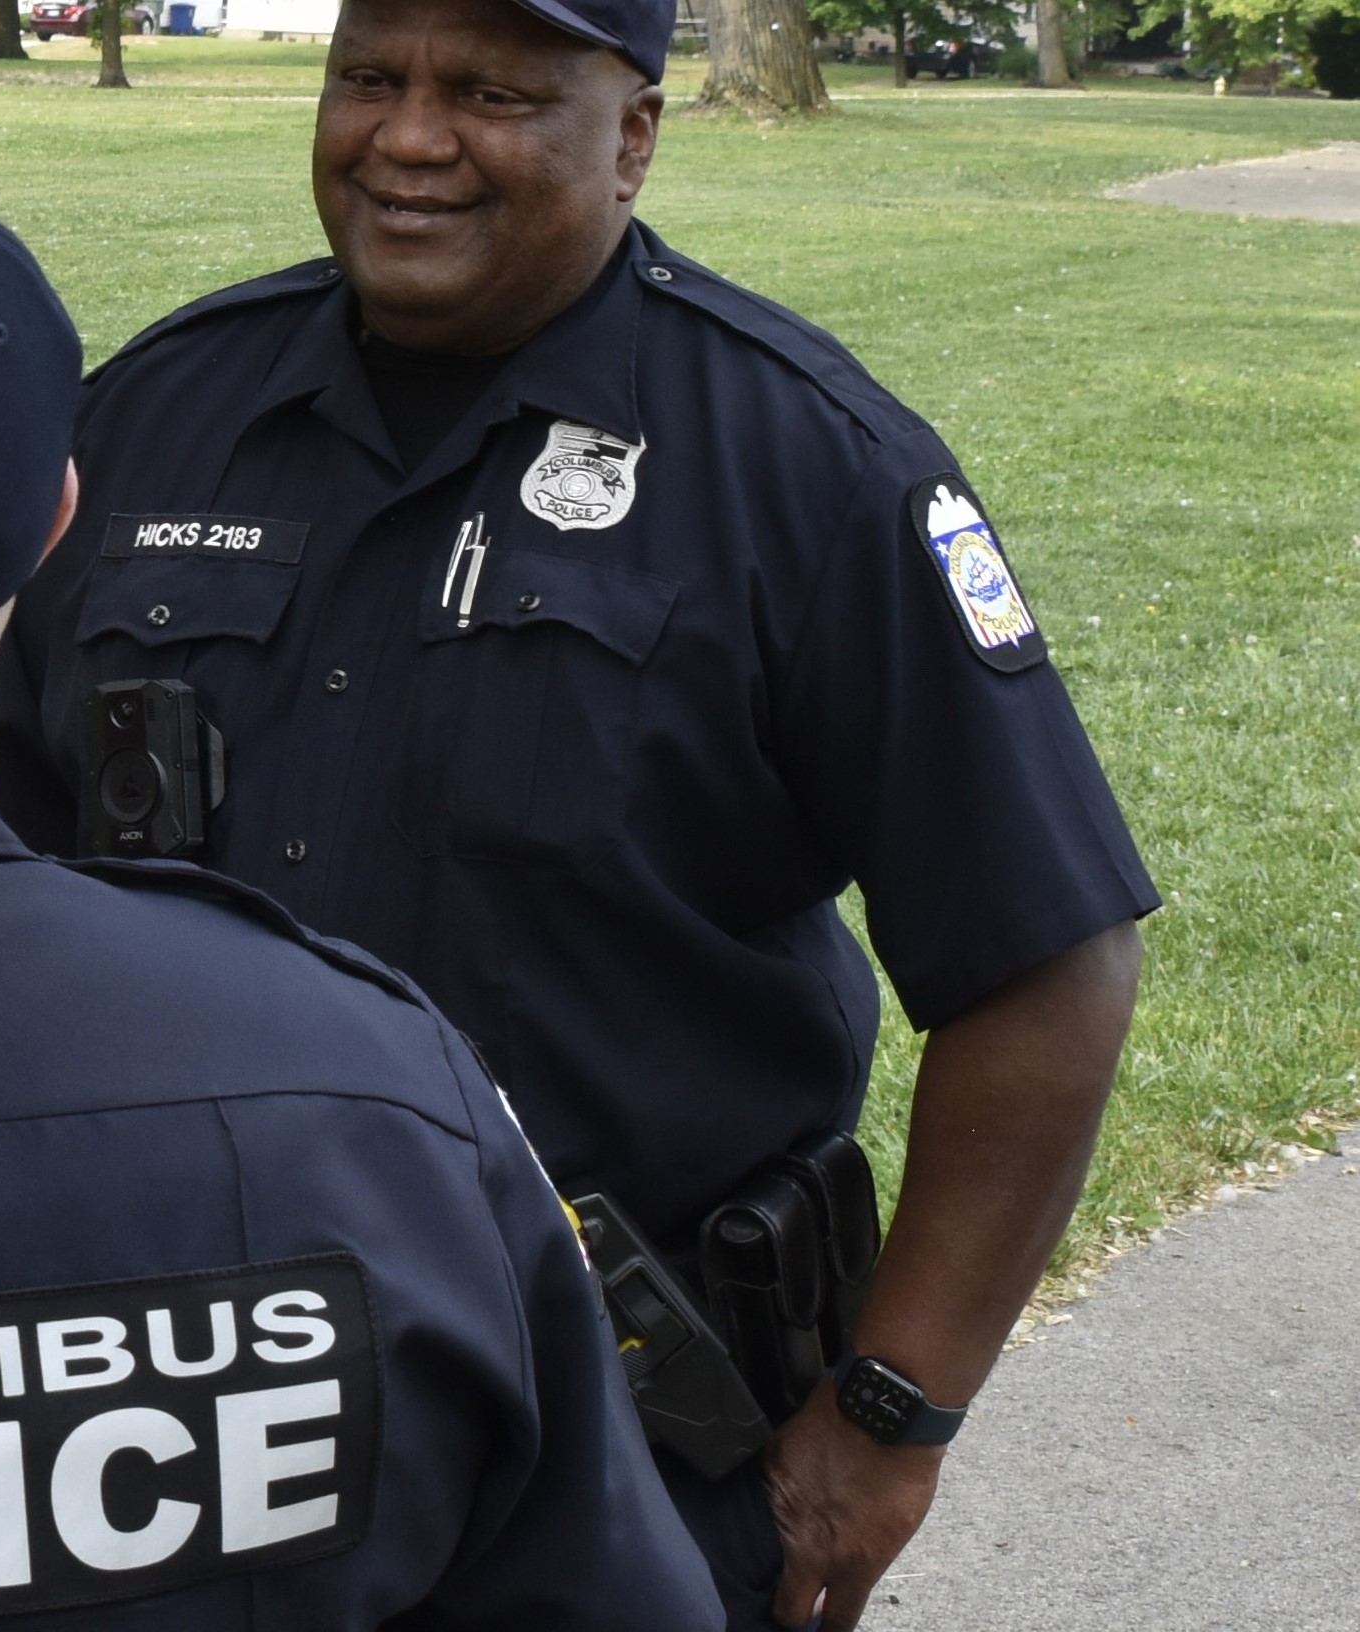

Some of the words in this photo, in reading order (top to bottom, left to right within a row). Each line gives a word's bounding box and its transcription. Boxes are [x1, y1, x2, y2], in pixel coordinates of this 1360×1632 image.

[552, 456, 617, 480] COLUMBUS
[546, 499, 593, 518] POLICE
[134, 522, 201, 547] HICKS
[202, 524, 262, 550] 2183
[981, 600, 1021, 630] POLICE
[119, 831, 143, 841] AXON
